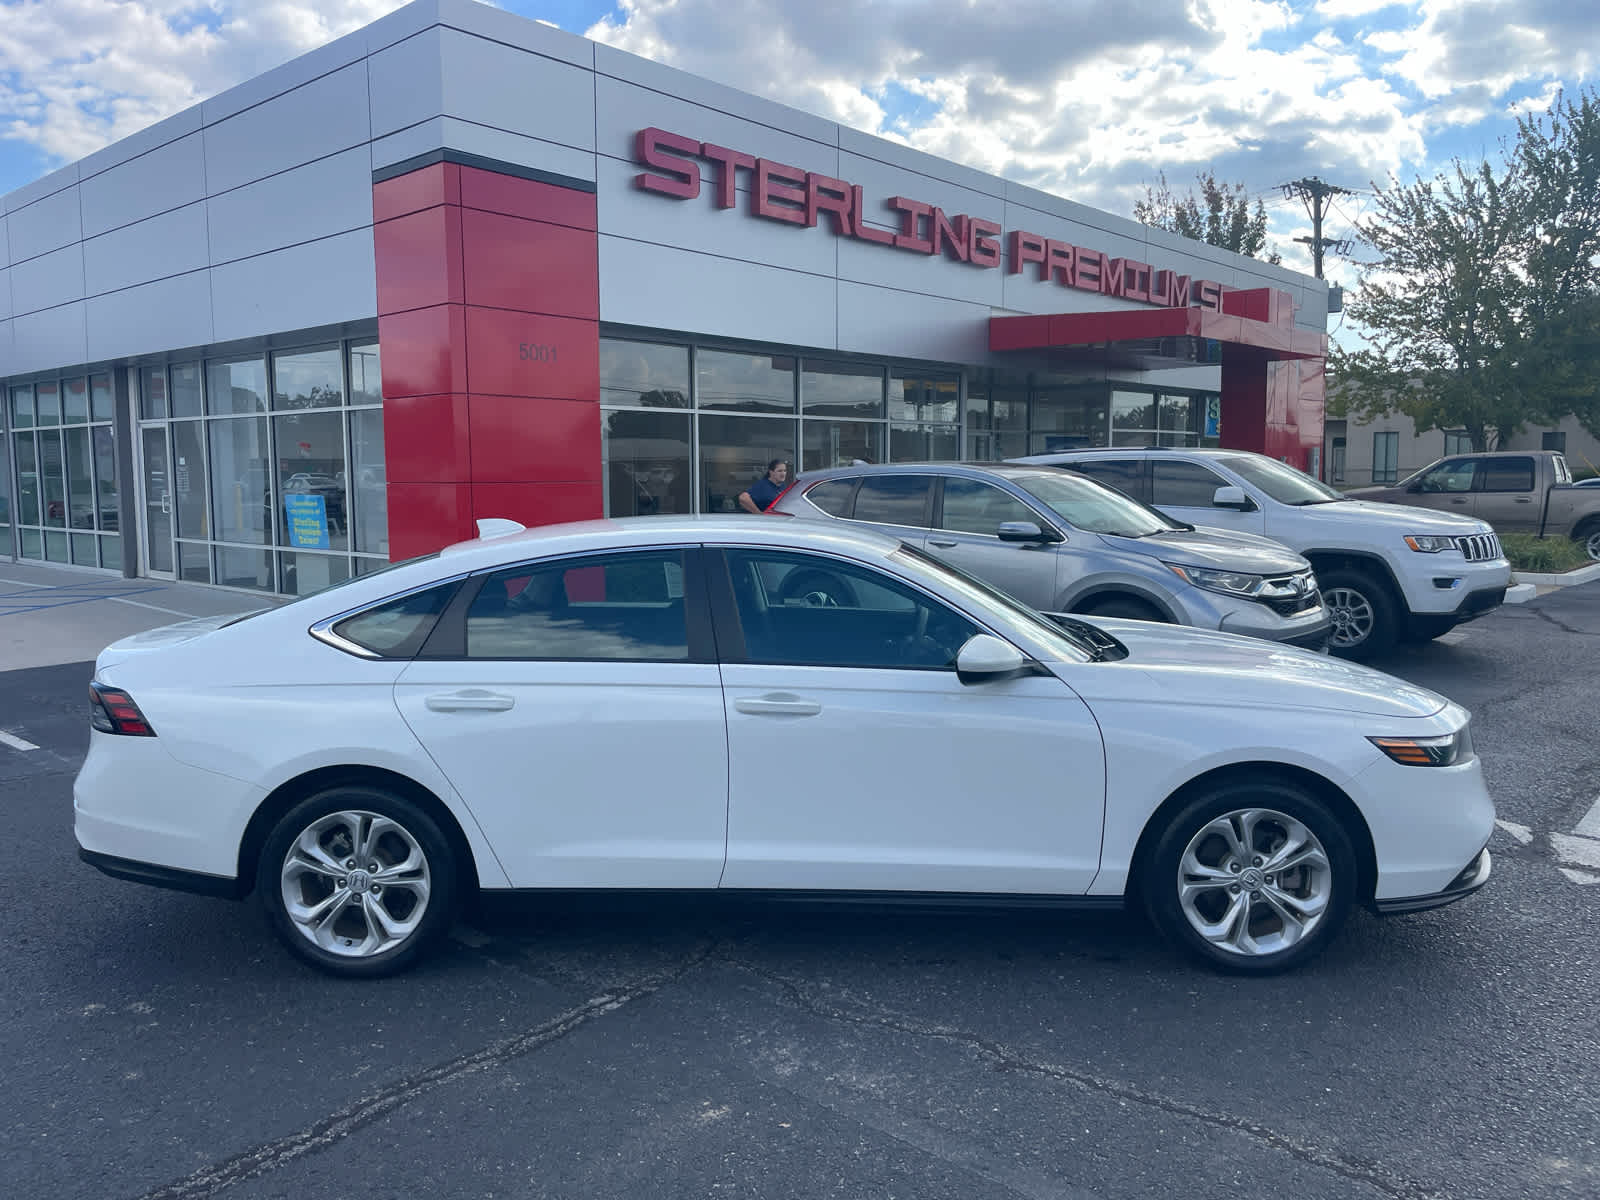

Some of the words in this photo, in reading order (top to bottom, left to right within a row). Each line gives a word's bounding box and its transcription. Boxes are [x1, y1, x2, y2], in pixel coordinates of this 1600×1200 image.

[635, 127, 1001, 268] STERLING
[1008, 230, 1191, 308] PREMIUM
[519, 342, 559, 363] 5001
